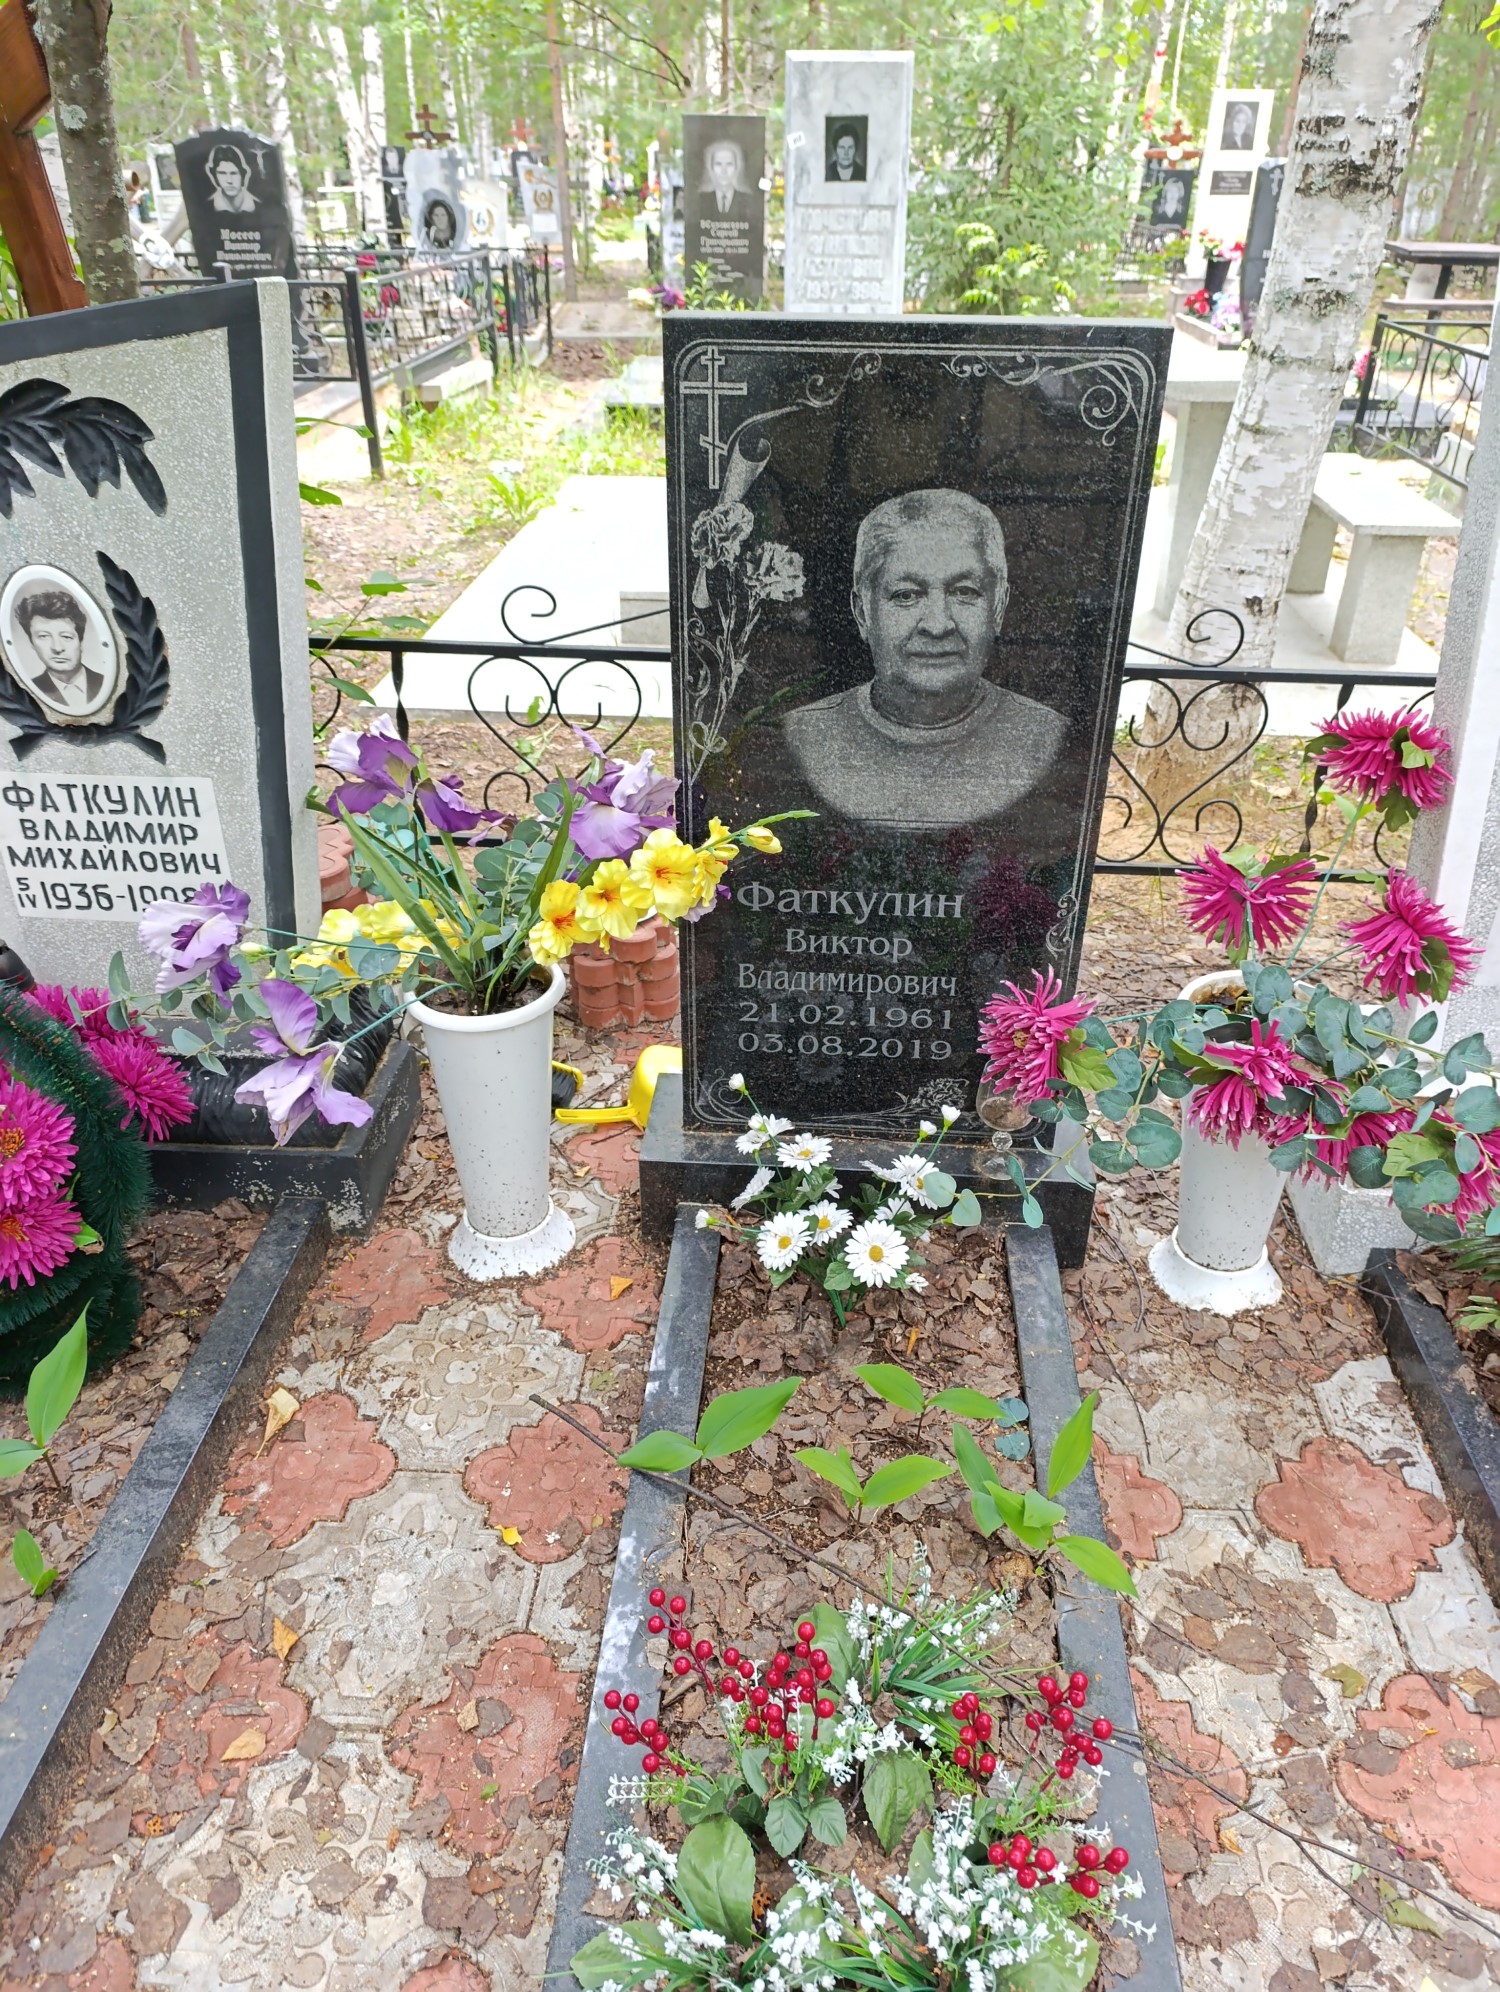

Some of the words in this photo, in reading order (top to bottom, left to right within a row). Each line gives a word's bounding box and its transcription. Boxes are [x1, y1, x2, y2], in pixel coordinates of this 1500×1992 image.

[2, 780, 201, 818] ФАТКУЛИН
[19, 818, 199, 845] ВЛАДИМИР
[7, 845, 222, 875] МИХАЙЛОВИЧ
[737, 881, 965, 925] Фаткулин
[786, 928, 913, 963] Виктор
[738, 963, 957, 1000] Владимирович
[738, 1002, 952, 1030] 21.02.1961
[738, 1032, 952, 1061] 03.08.2019
